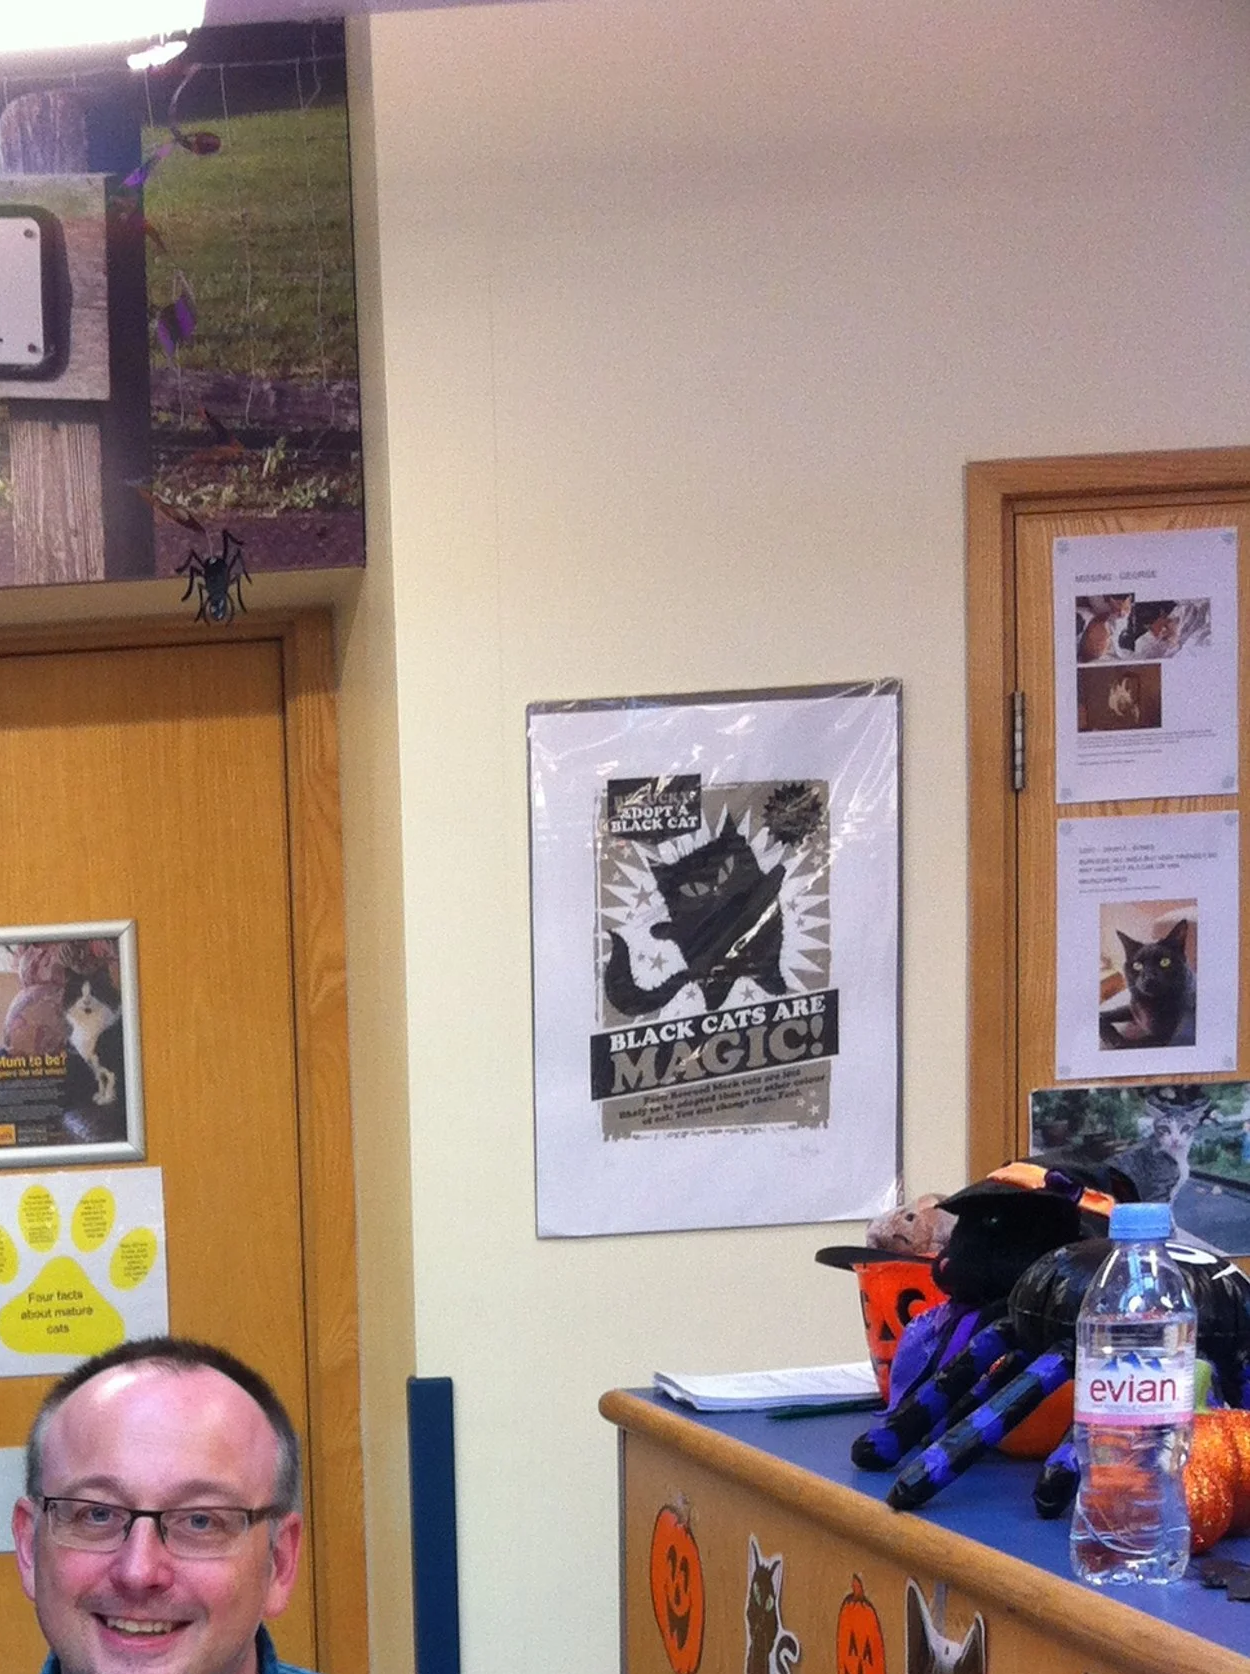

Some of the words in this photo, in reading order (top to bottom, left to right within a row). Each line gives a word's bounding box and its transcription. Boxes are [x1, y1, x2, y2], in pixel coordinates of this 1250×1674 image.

[620, 805, 673, 820] ADOPT
[678, 803, 689, 817] A
[611, 819, 664, 833] BLACK
[667, 816, 699, 830] CAT
[609, 1020, 696, 1052] BLACK
[701, 1006, 767, 1034] CATS
[772, 995, 827, 1021] ARE
[29, 1056, 43, 1068] to
[610, 1014, 825, 1094] MAGIC!
[28, 1291, 54, 1304] Four
[56, 1290, 84, 1301] facts
[20, 1309, 52, 1320] about
[54, 1305, 94, 1317] mature
[46, 1324, 70, 1334] cats
[1089, 1374, 1177, 1402] evian
